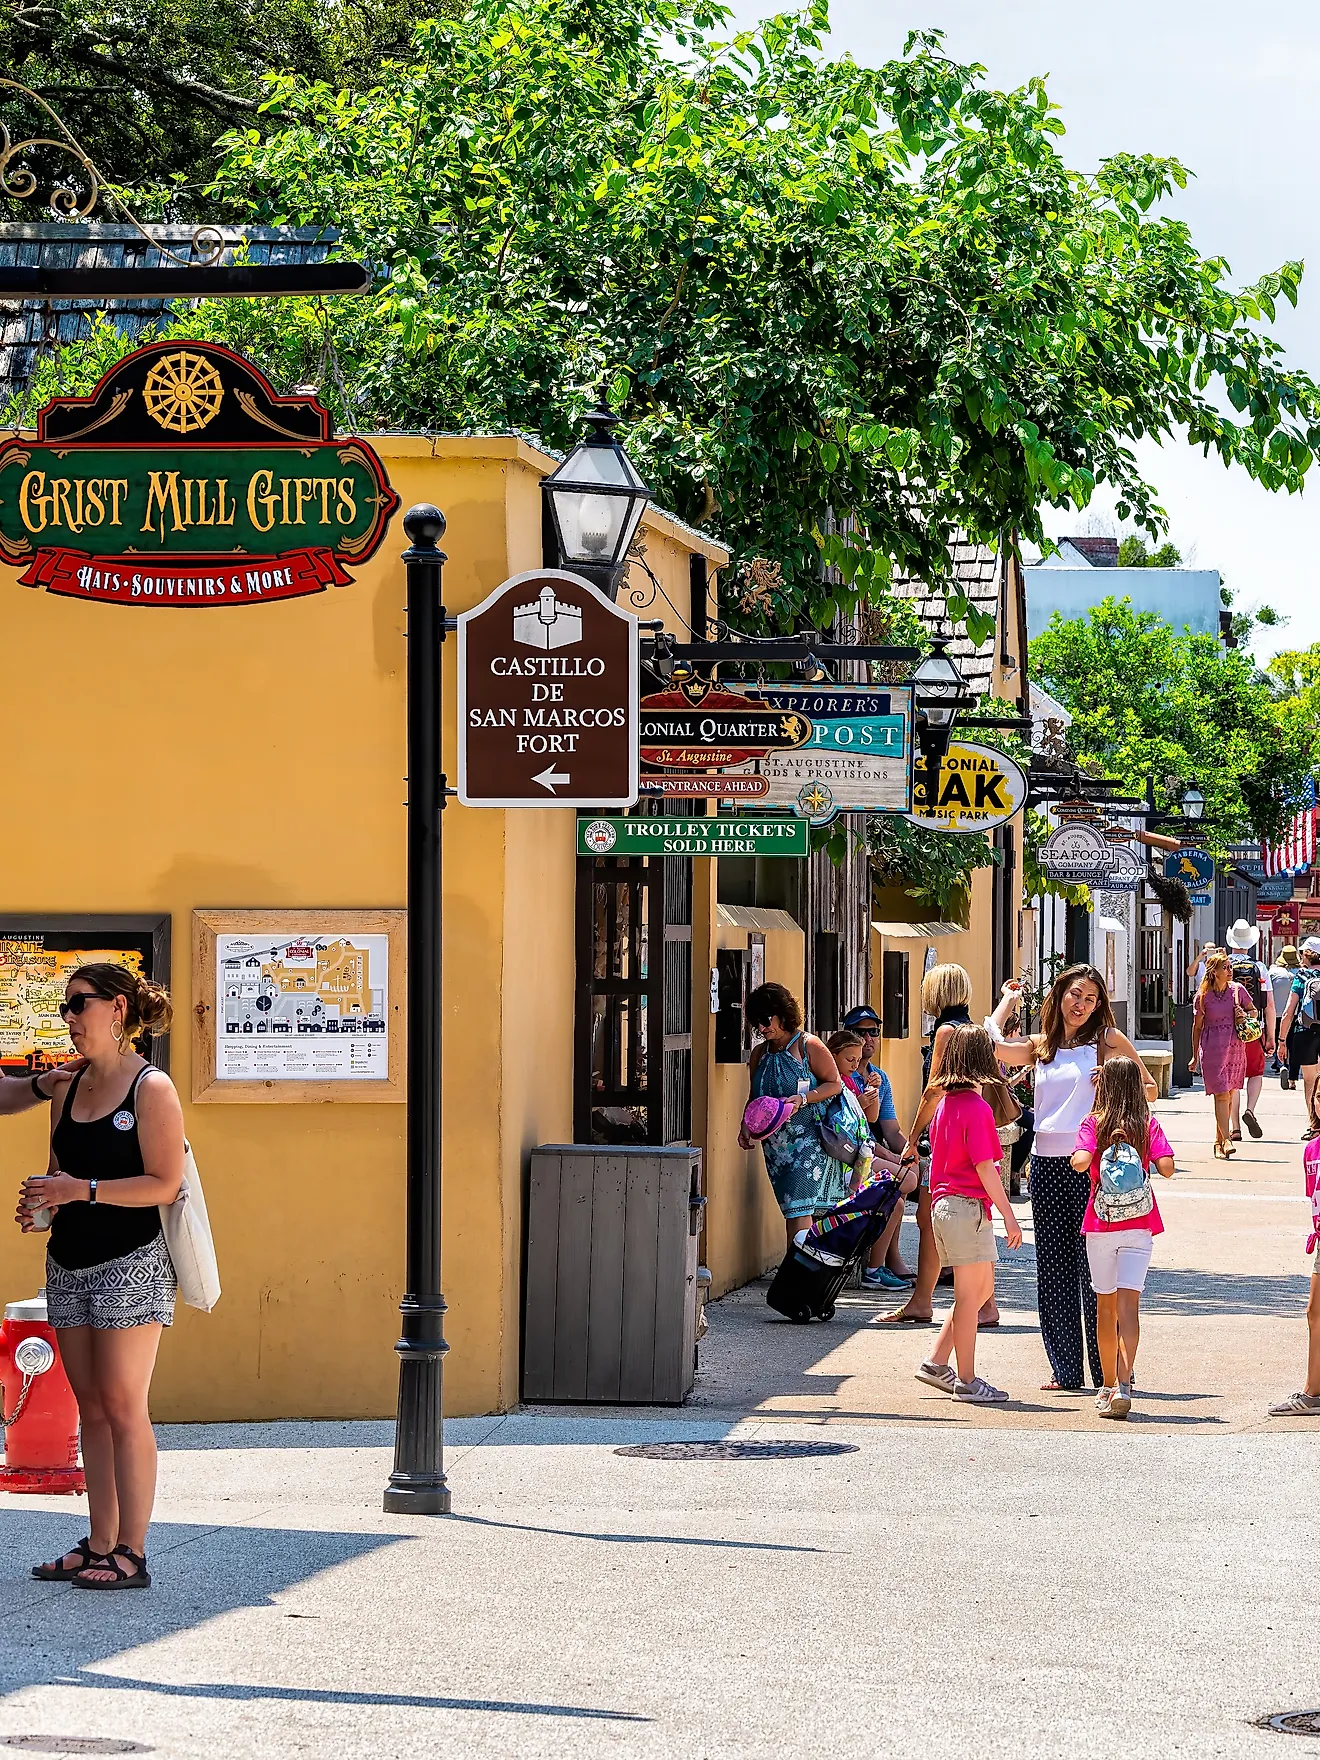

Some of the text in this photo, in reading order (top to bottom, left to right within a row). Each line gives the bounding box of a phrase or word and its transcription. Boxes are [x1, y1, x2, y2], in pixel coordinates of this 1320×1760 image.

[18, 470, 358, 543] GRIST MILL GIFTS
[77, 566, 294, 597] HATS SOUVENIRS & MORE
[490, 657, 605, 677] CASTILLO
[531, 684, 563, 702] DE
[772, 696, 880, 713] XPLORER'S
[470, 708, 626, 728] SAN MARCOS
[640, 718, 779, 742] LONIAL QUARTER
[813, 725, 899, 746] POST
[516, 734, 579, 753] FORT
[656, 750, 733, 764] St. Augustine
[786, 759, 864, 768] AUGUSTINE
[743, 768, 788, 777] GODS
[808, 769, 889, 780] PROVISIONS
[662, 781, 722, 792] ENTRANCE
[724, 781, 763, 792] AHEAD
[960, 810, 989, 820] PARK
[625, 822, 713, 838] TROLLEY
[718, 822, 796, 838] TICKETS
[663, 838, 756, 853] SOLD HERE
[1040, 849, 1111, 861] SEAFOOD
[1172, 850, 1208, 862] TABERNA
[0, 941, 44, 955] IRATE
[5, 955, 57, 966] TREASURE
